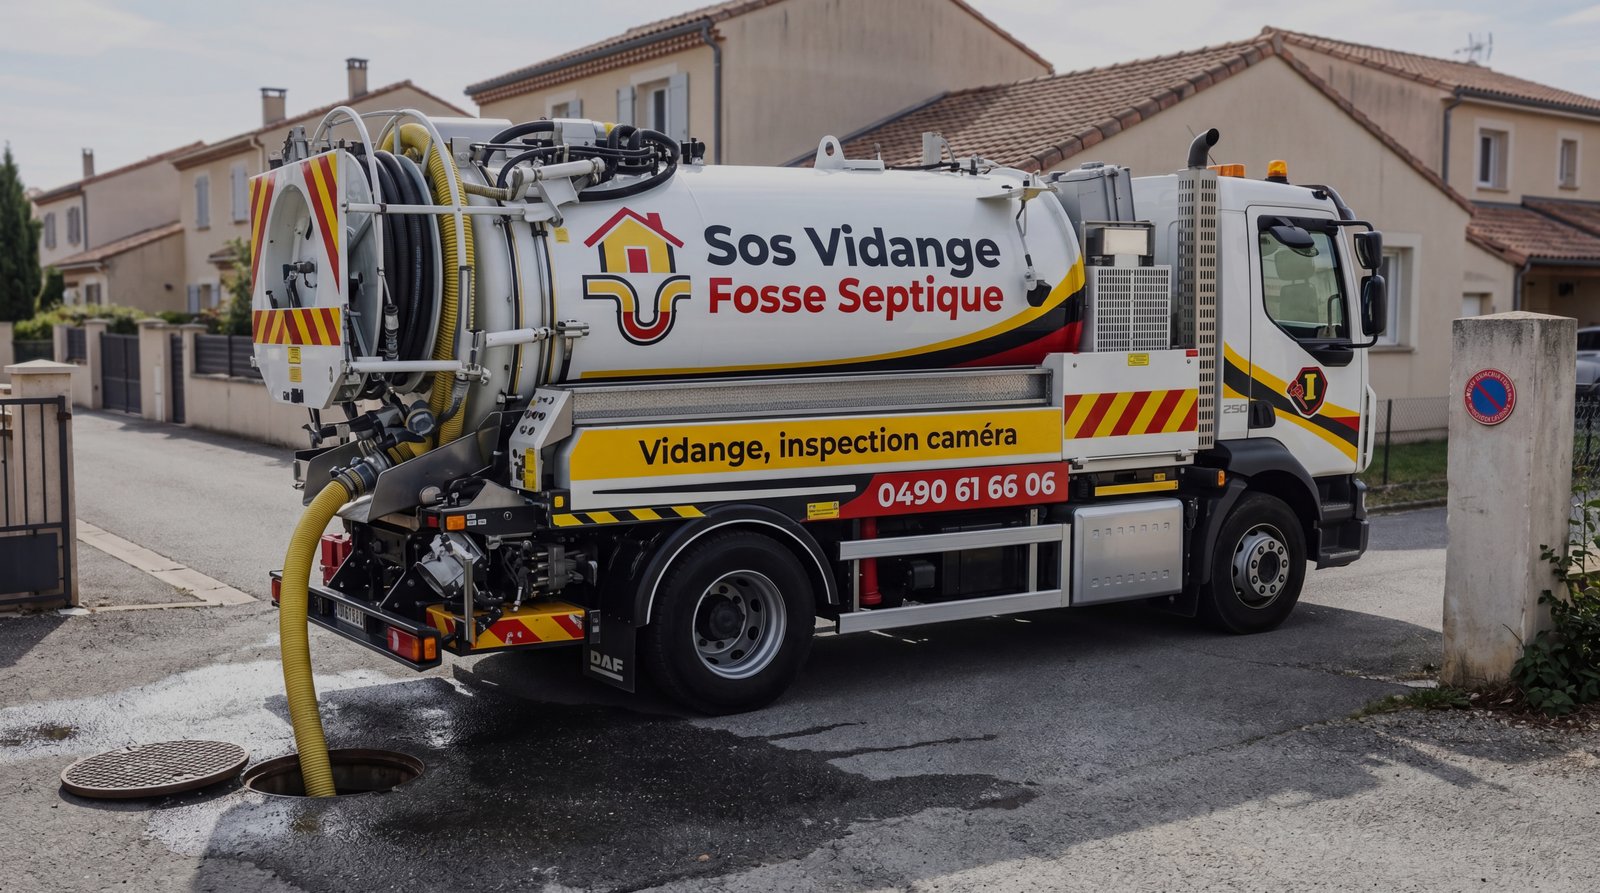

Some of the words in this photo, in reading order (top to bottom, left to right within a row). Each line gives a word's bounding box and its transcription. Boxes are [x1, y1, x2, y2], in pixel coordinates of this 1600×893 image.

[704, 224, 797, 266] Sos
[803, 223, 1001, 279] Vidange
[709, 277, 827, 314] Fosse
[838, 274, 1004, 321] Septique
[1223, 403, 1248, 414] 250
[638, 435, 772, 467] Vidange,
[779, 426, 919, 462] inspection
[926, 422, 1018, 452] caméra
[877, 478, 948, 508] 0490
[954, 476, 981, 502] 61
[987, 474, 1019, 499] 66
[1025, 471, 1057, 497] 06
[590, 650, 624, 672] DAF
